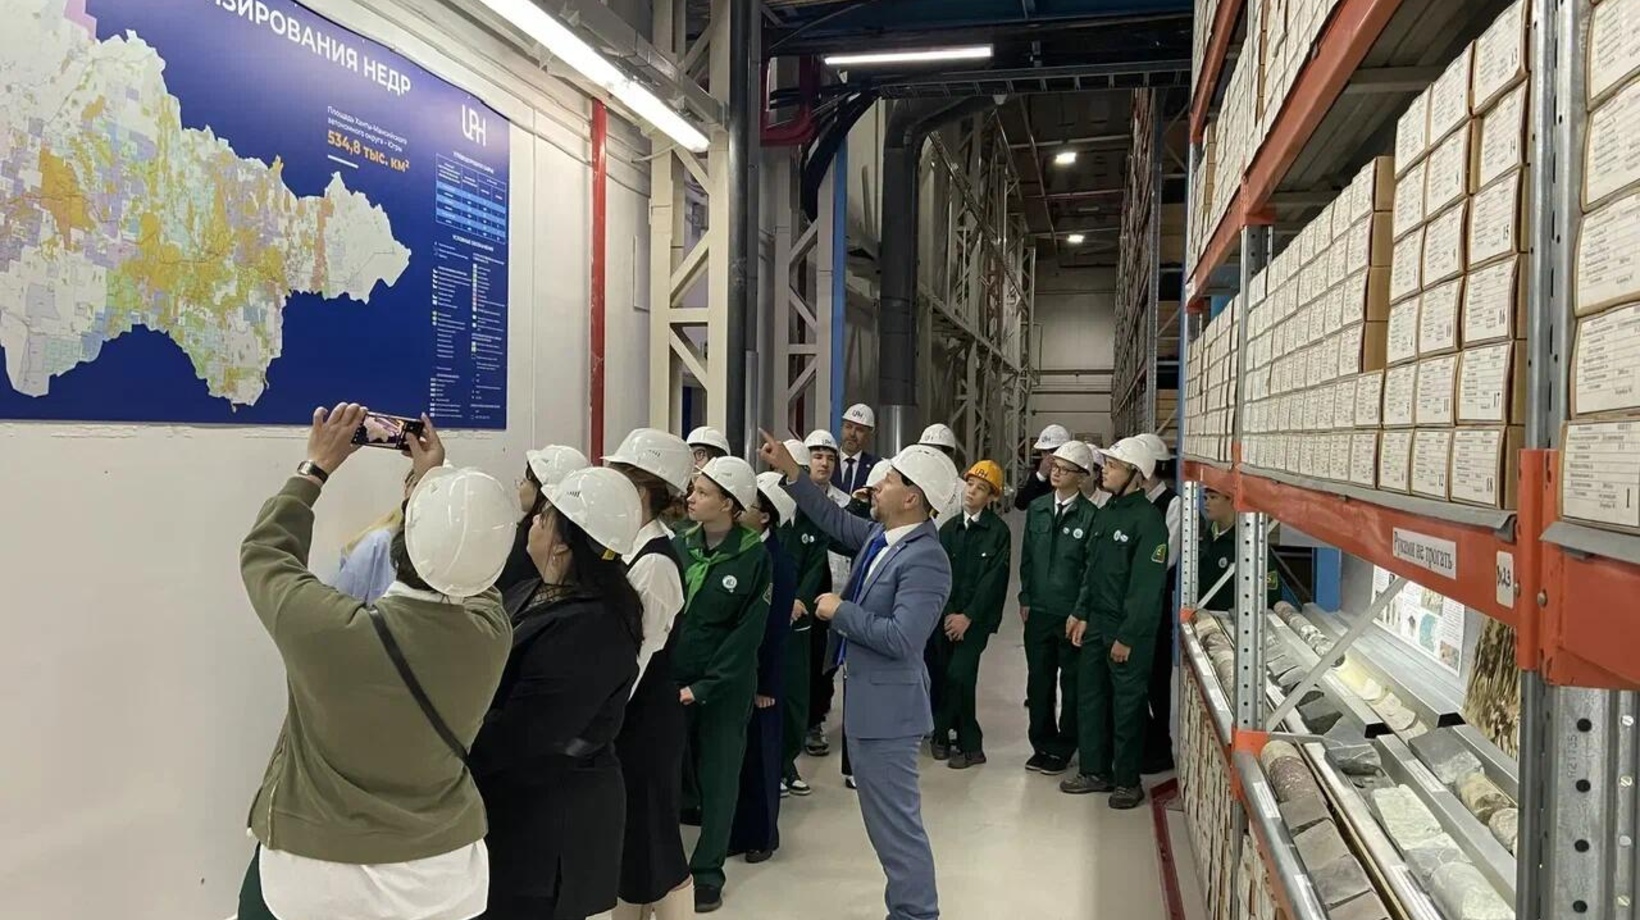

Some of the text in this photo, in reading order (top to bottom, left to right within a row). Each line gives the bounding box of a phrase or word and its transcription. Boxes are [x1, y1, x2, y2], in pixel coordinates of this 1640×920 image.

[215, 0, 411, 96] ИРОВАНИЯ НЕДР
[328, 129, 361, 155] 534,8
[363, 145, 388, 166] тыс.
[1416, 543, 1424, 560] не
